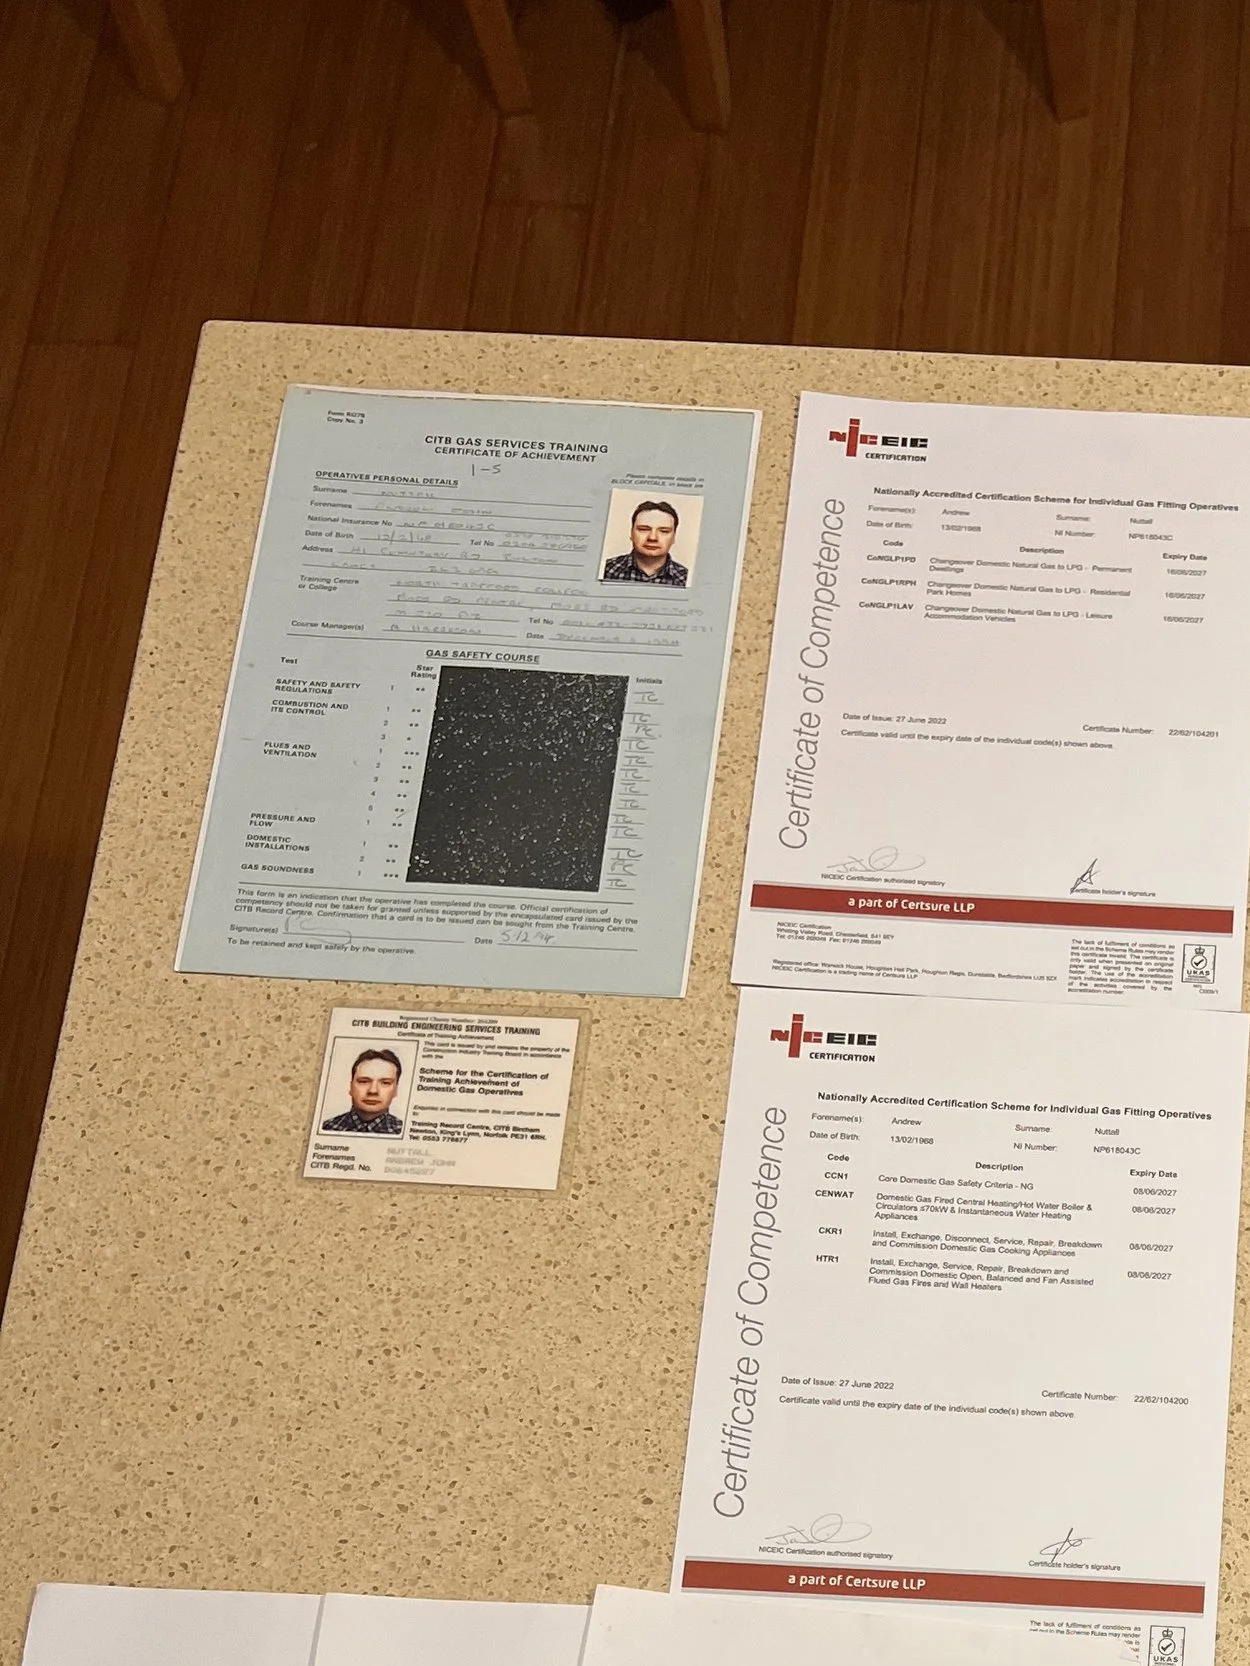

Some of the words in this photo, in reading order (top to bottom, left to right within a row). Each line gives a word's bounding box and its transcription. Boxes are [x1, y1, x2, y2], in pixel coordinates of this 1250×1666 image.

[423, 434, 452, 445] CITB
[454, 436, 482, 447] GAS
[484, 437, 546, 450] SERVICES
[548, 441, 608, 454] TRAINING
[433, 445, 501, 458] CERTIFICATE
[503, 449, 519, 458] OF
[519, 450, 597, 463] ACHIEVEMENT
[863, 451, 927, 462] CERTIFICATION
[800, 498, 845, 669] Competence
[425, 648, 449, 659] GAS
[449, 650, 493, 661] SAFETY
[494, 652, 541, 664] COURSE
[798, 672, 826, 704] of
[779, 712, 821, 850] Certificate
[847, 896, 856, 907] a
[857, 897, 883, 909] part
[884, 897, 899, 909] of
[899, 898, 951, 912] Certsure
[952, 901, 976, 913] LLP
[350, 1018, 370, 1028] CITB
[370, 1018, 409, 1030] BUILDING
[409, 1020, 463, 1032] ENGINEERING
[464, 1023, 502, 1034] SERVICES
[503, 1025, 541, 1036] TRAINING
[808, 1050, 876, 1063] CERTIFICATION
[816, 1090, 868, 1105] Nationally
[869, 1093, 925, 1106] Accredited
[925, 1096, 988, 1109] Certification
[989, 1100, 1031, 1112] Scheme
[1032, 1102, 1048, 1113] for
[1049, 1103, 1099, 1115] Individual
[1100, 1105, 1121, 1116] Gas
[1122, 1106, 1156, 1119] Fitting
[1157, 1107, 1212, 1121] Operatives
[823, 1170, 848, 1180] CCN1
[813, 1188, 855, 1199] CENWAT
[817, 1225, 843, 1235] CKR1
[814, 1253, 839, 1263] HTR1
[1152, 1654, 1179, 1664] UKAS
